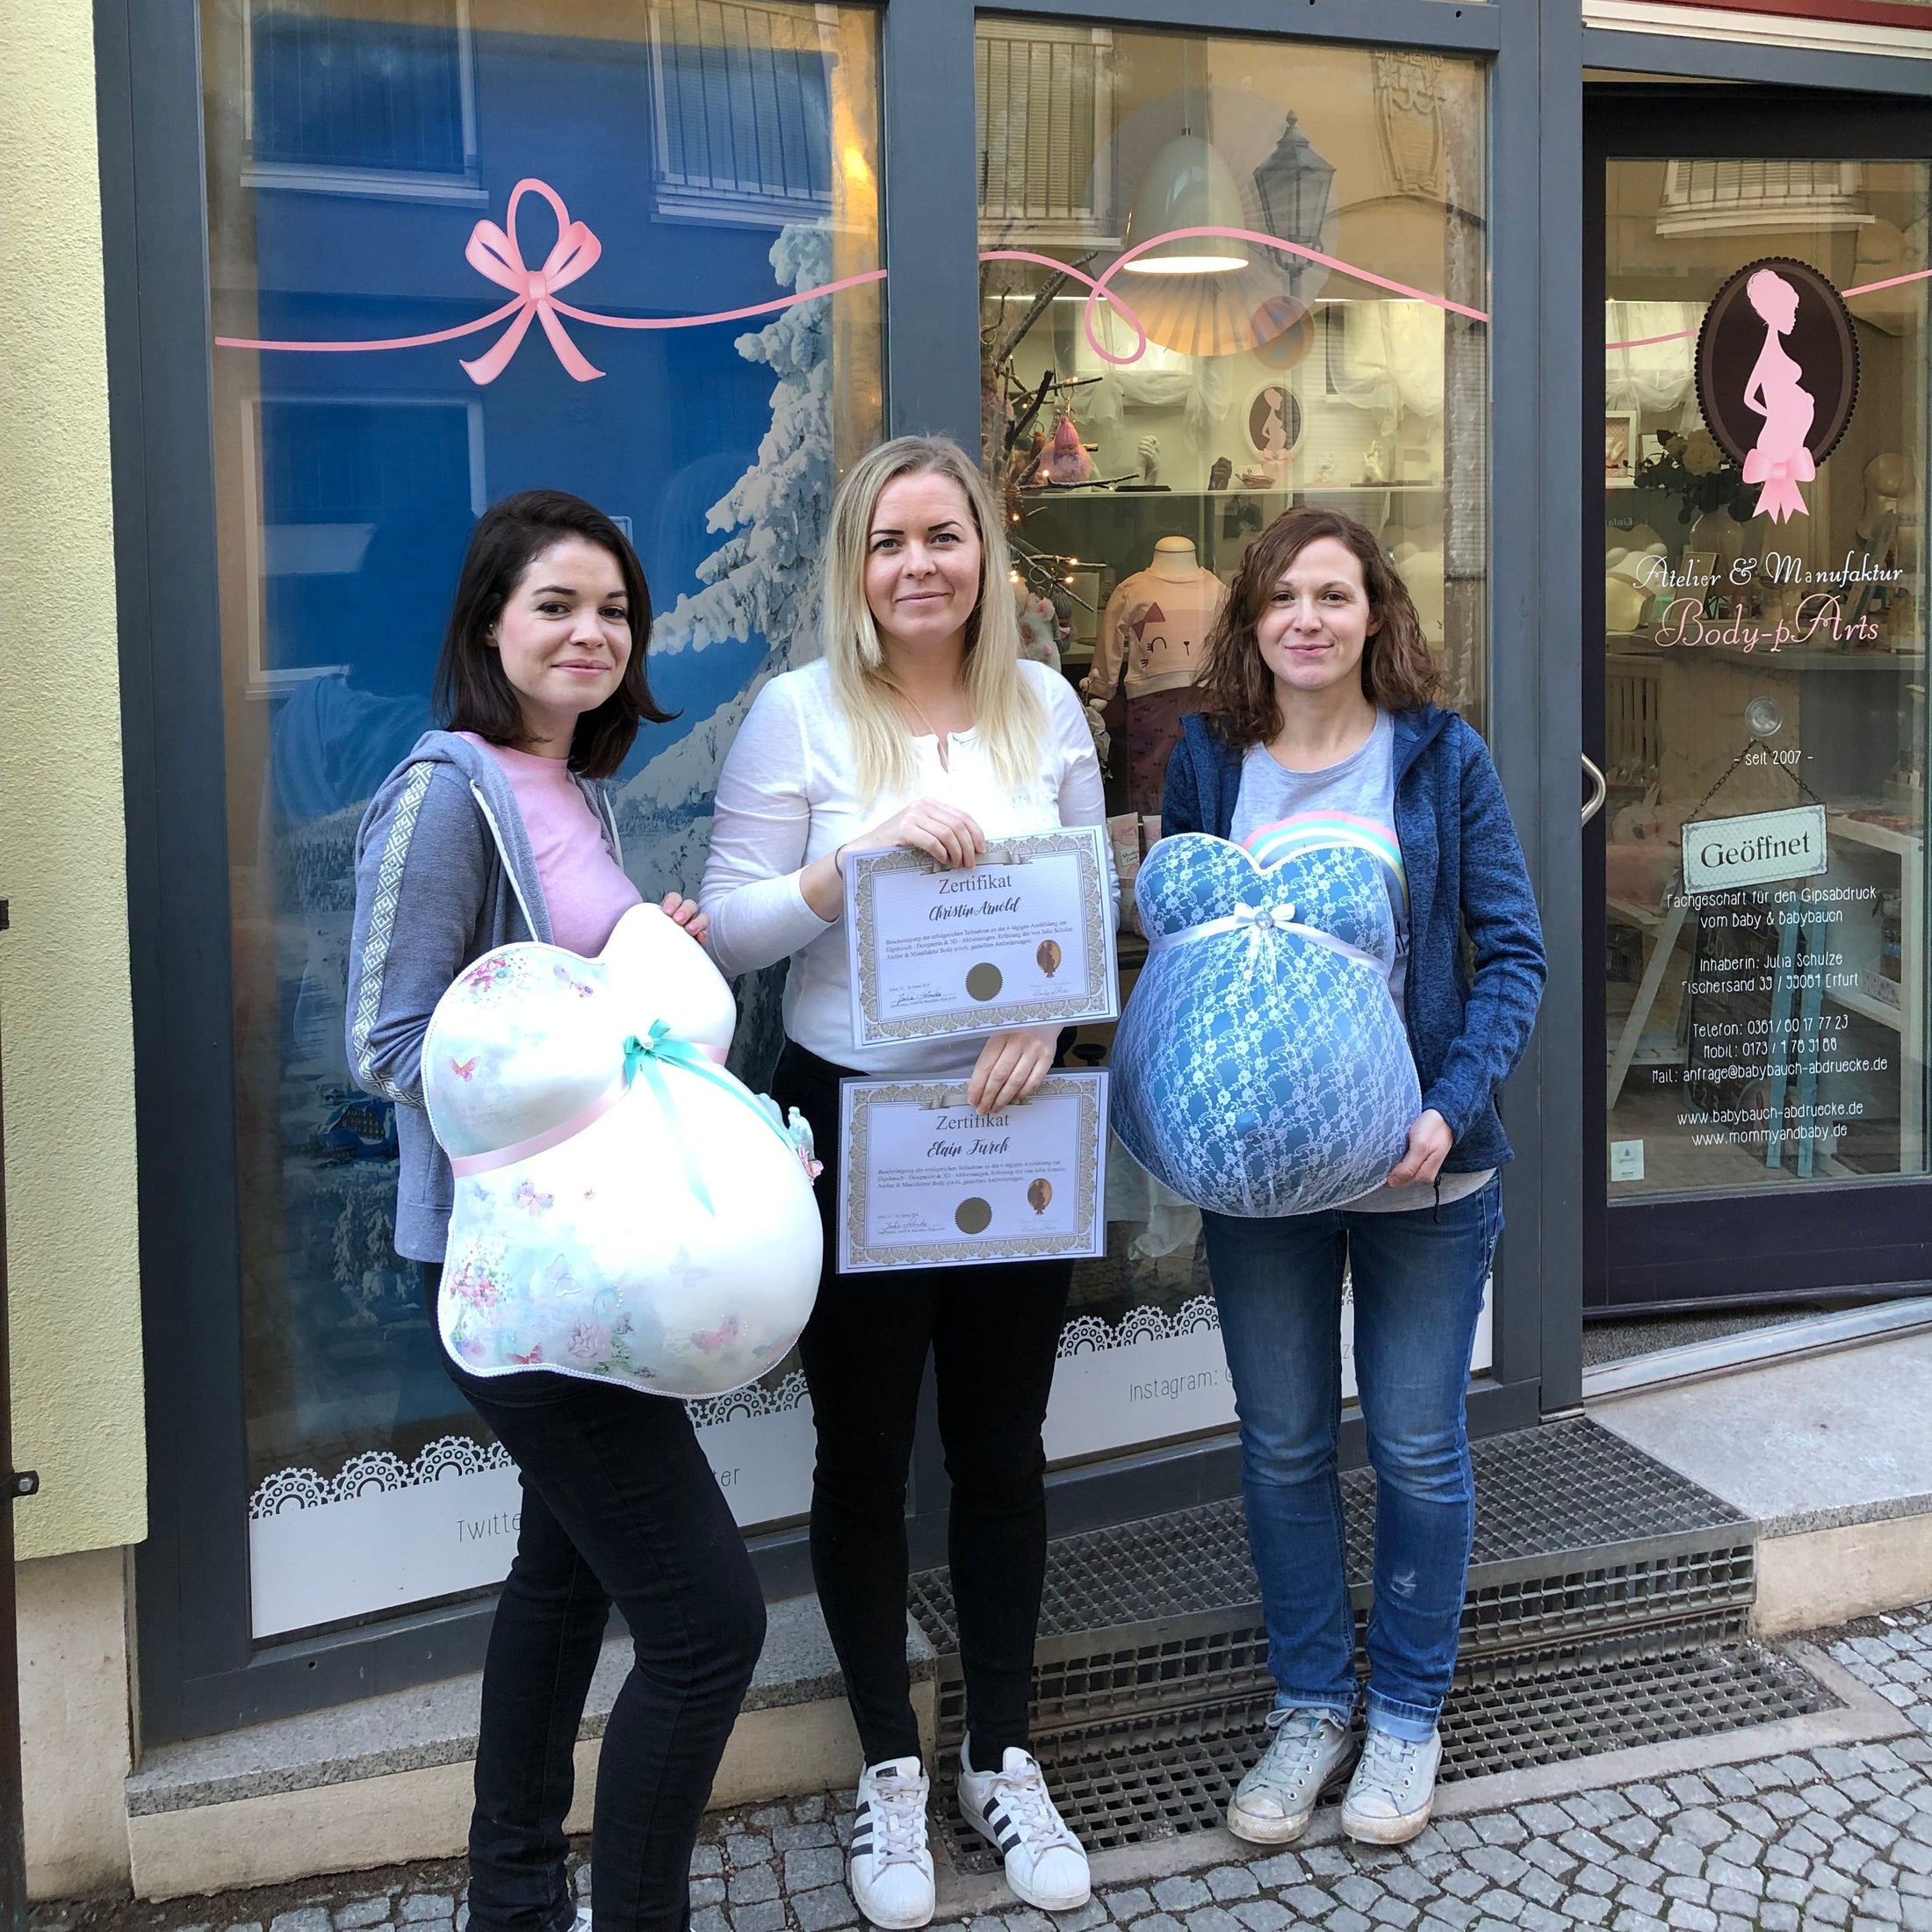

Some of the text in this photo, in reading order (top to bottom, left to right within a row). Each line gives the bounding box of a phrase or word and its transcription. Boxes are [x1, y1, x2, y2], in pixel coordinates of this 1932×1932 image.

[1633, 550, 1904, 588] Atelier & Manufaktur
[1654, 593, 1879, 652] Body-pArts
[1745, 753, 1767, 766] seit
[1773, 751, 1801, 764] 2007
[1700, 831, 1810, 868] Geöffnet
[939, 874, 1013, 894] Zertifikat
[1752, 890, 1770, 904] für
[1775, 890, 1797, 903] den
[1801, 885, 1877, 905] Gipsabdruck
[929, 897, 1020, 921] Christin Arnold
[1700, 910, 1842, 929] vom Baby & Babybauch
[1699, 951, 1842, 972] Inhaberin: Julia Schulze
[1759, 976, 1772, 991] 39
[1777, 976, 1782, 992] /
[1826, 972, 1859, 988] Erfurt
[1693, 1022, 1743, 1037] Telefon:
[1803, 1018, 1813, 1031] 17
[1818, 1016, 1831, 1030] 77
[1835, 1014, 1848, 1029] 23
[1704, 1043, 1738, 1058] Mobil:
[1742, 1042, 1768, 1056] 0173
[1791, 1039, 1805, 1053] 78
[1822, 1037, 1837, 1052] 88
[1652, 1056, 1888, 1084] Mail: anfrage@babybauch-abdruecke.de
[935, 1114, 1010, 1130] Zertifikat
[1677, 1100, 1864, 1125] www.babybauch-abdruecke.de
[1691, 1123, 1848, 1146] www.mommyandbaby.de
[1129, 1369, 1218, 1402] Instagram:
